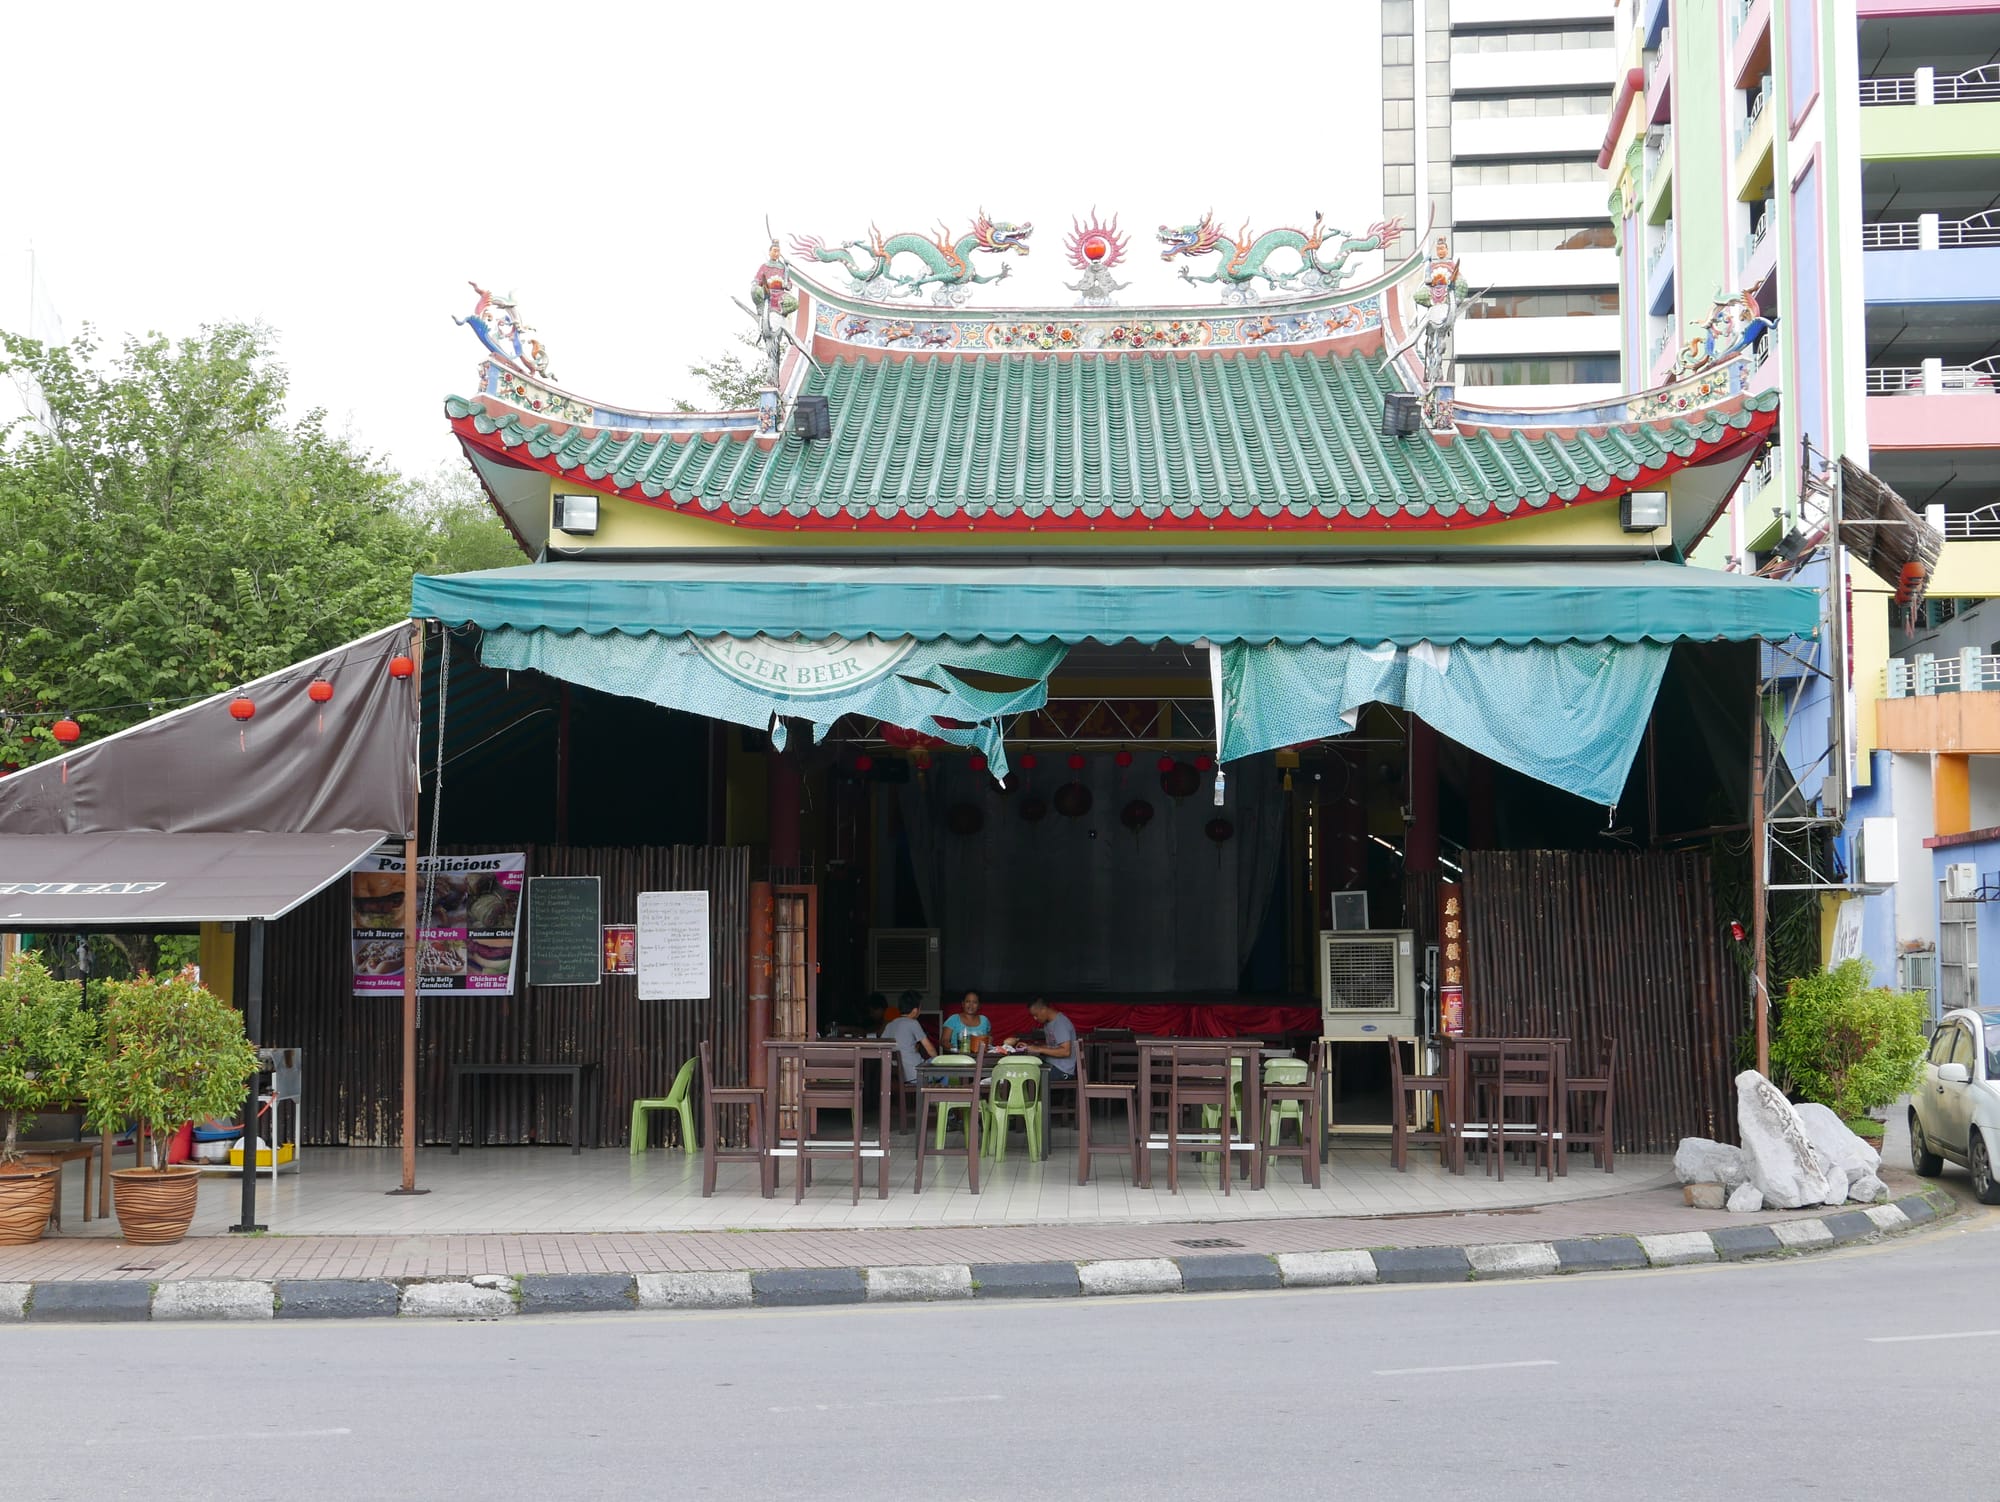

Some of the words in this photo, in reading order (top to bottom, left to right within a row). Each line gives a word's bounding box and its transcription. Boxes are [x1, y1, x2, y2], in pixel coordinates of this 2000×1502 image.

[797, 656, 863, 684] BEER
[376, 930, 404, 938] Burger
[438, 930, 458, 938] Pork
[377, 979, 401, 987] Hotdog
[436, 976, 454, 985] Belly
